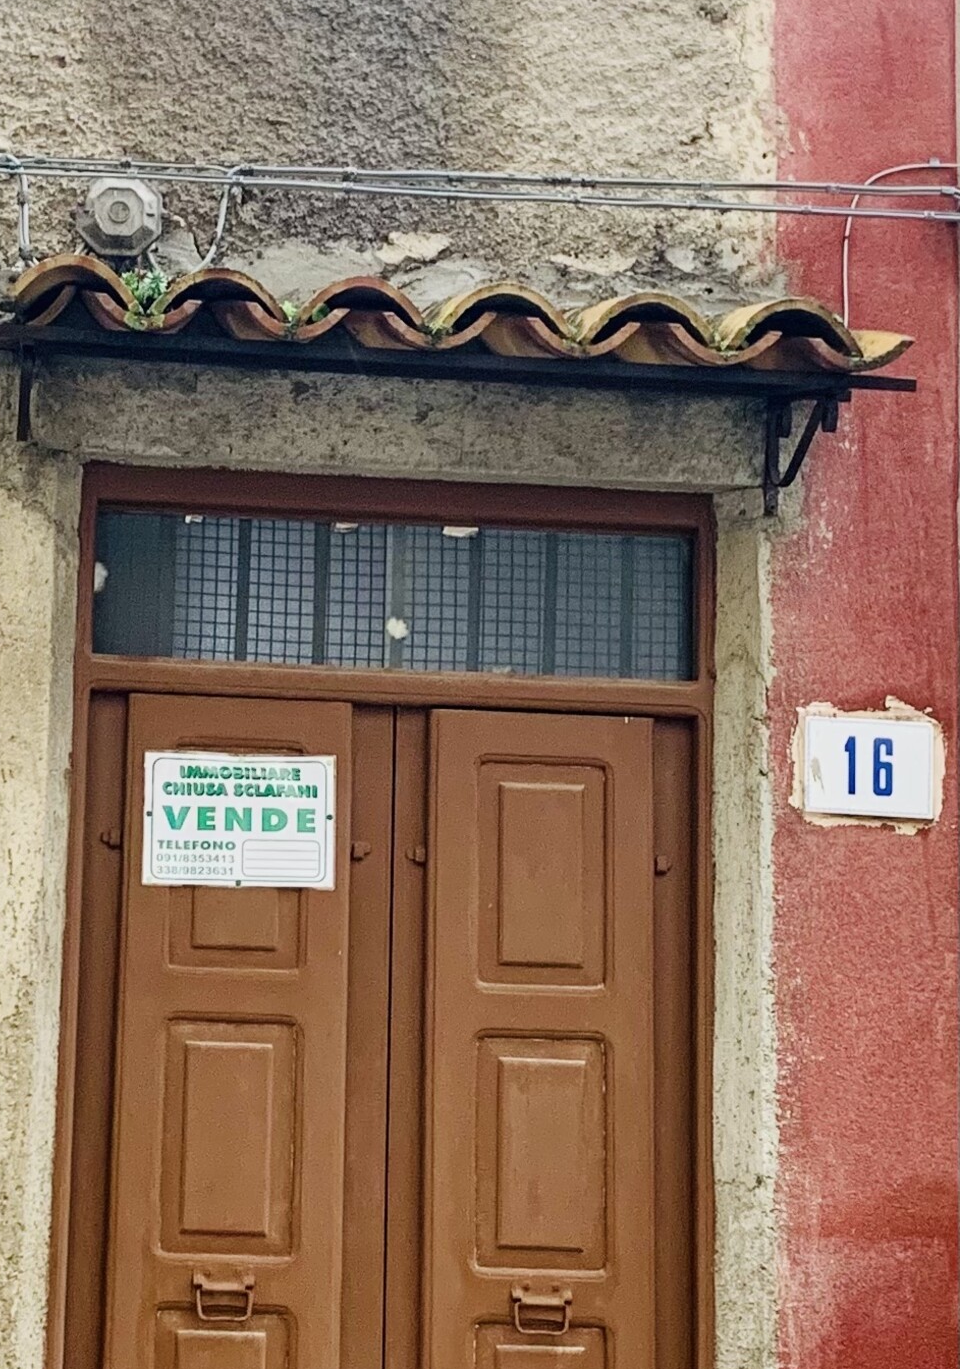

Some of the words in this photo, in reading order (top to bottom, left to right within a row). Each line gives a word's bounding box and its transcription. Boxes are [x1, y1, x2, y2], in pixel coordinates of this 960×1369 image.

[179, 765, 301, 781] IMMOBILIARE
[844, 735, 893, 796] 16
[161, 781, 228, 797] CHIUSA
[233, 782, 318, 799] SCLAFANI
[162, 805, 317, 833] VENDE
[157, 839, 236, 851] TELEFONO
